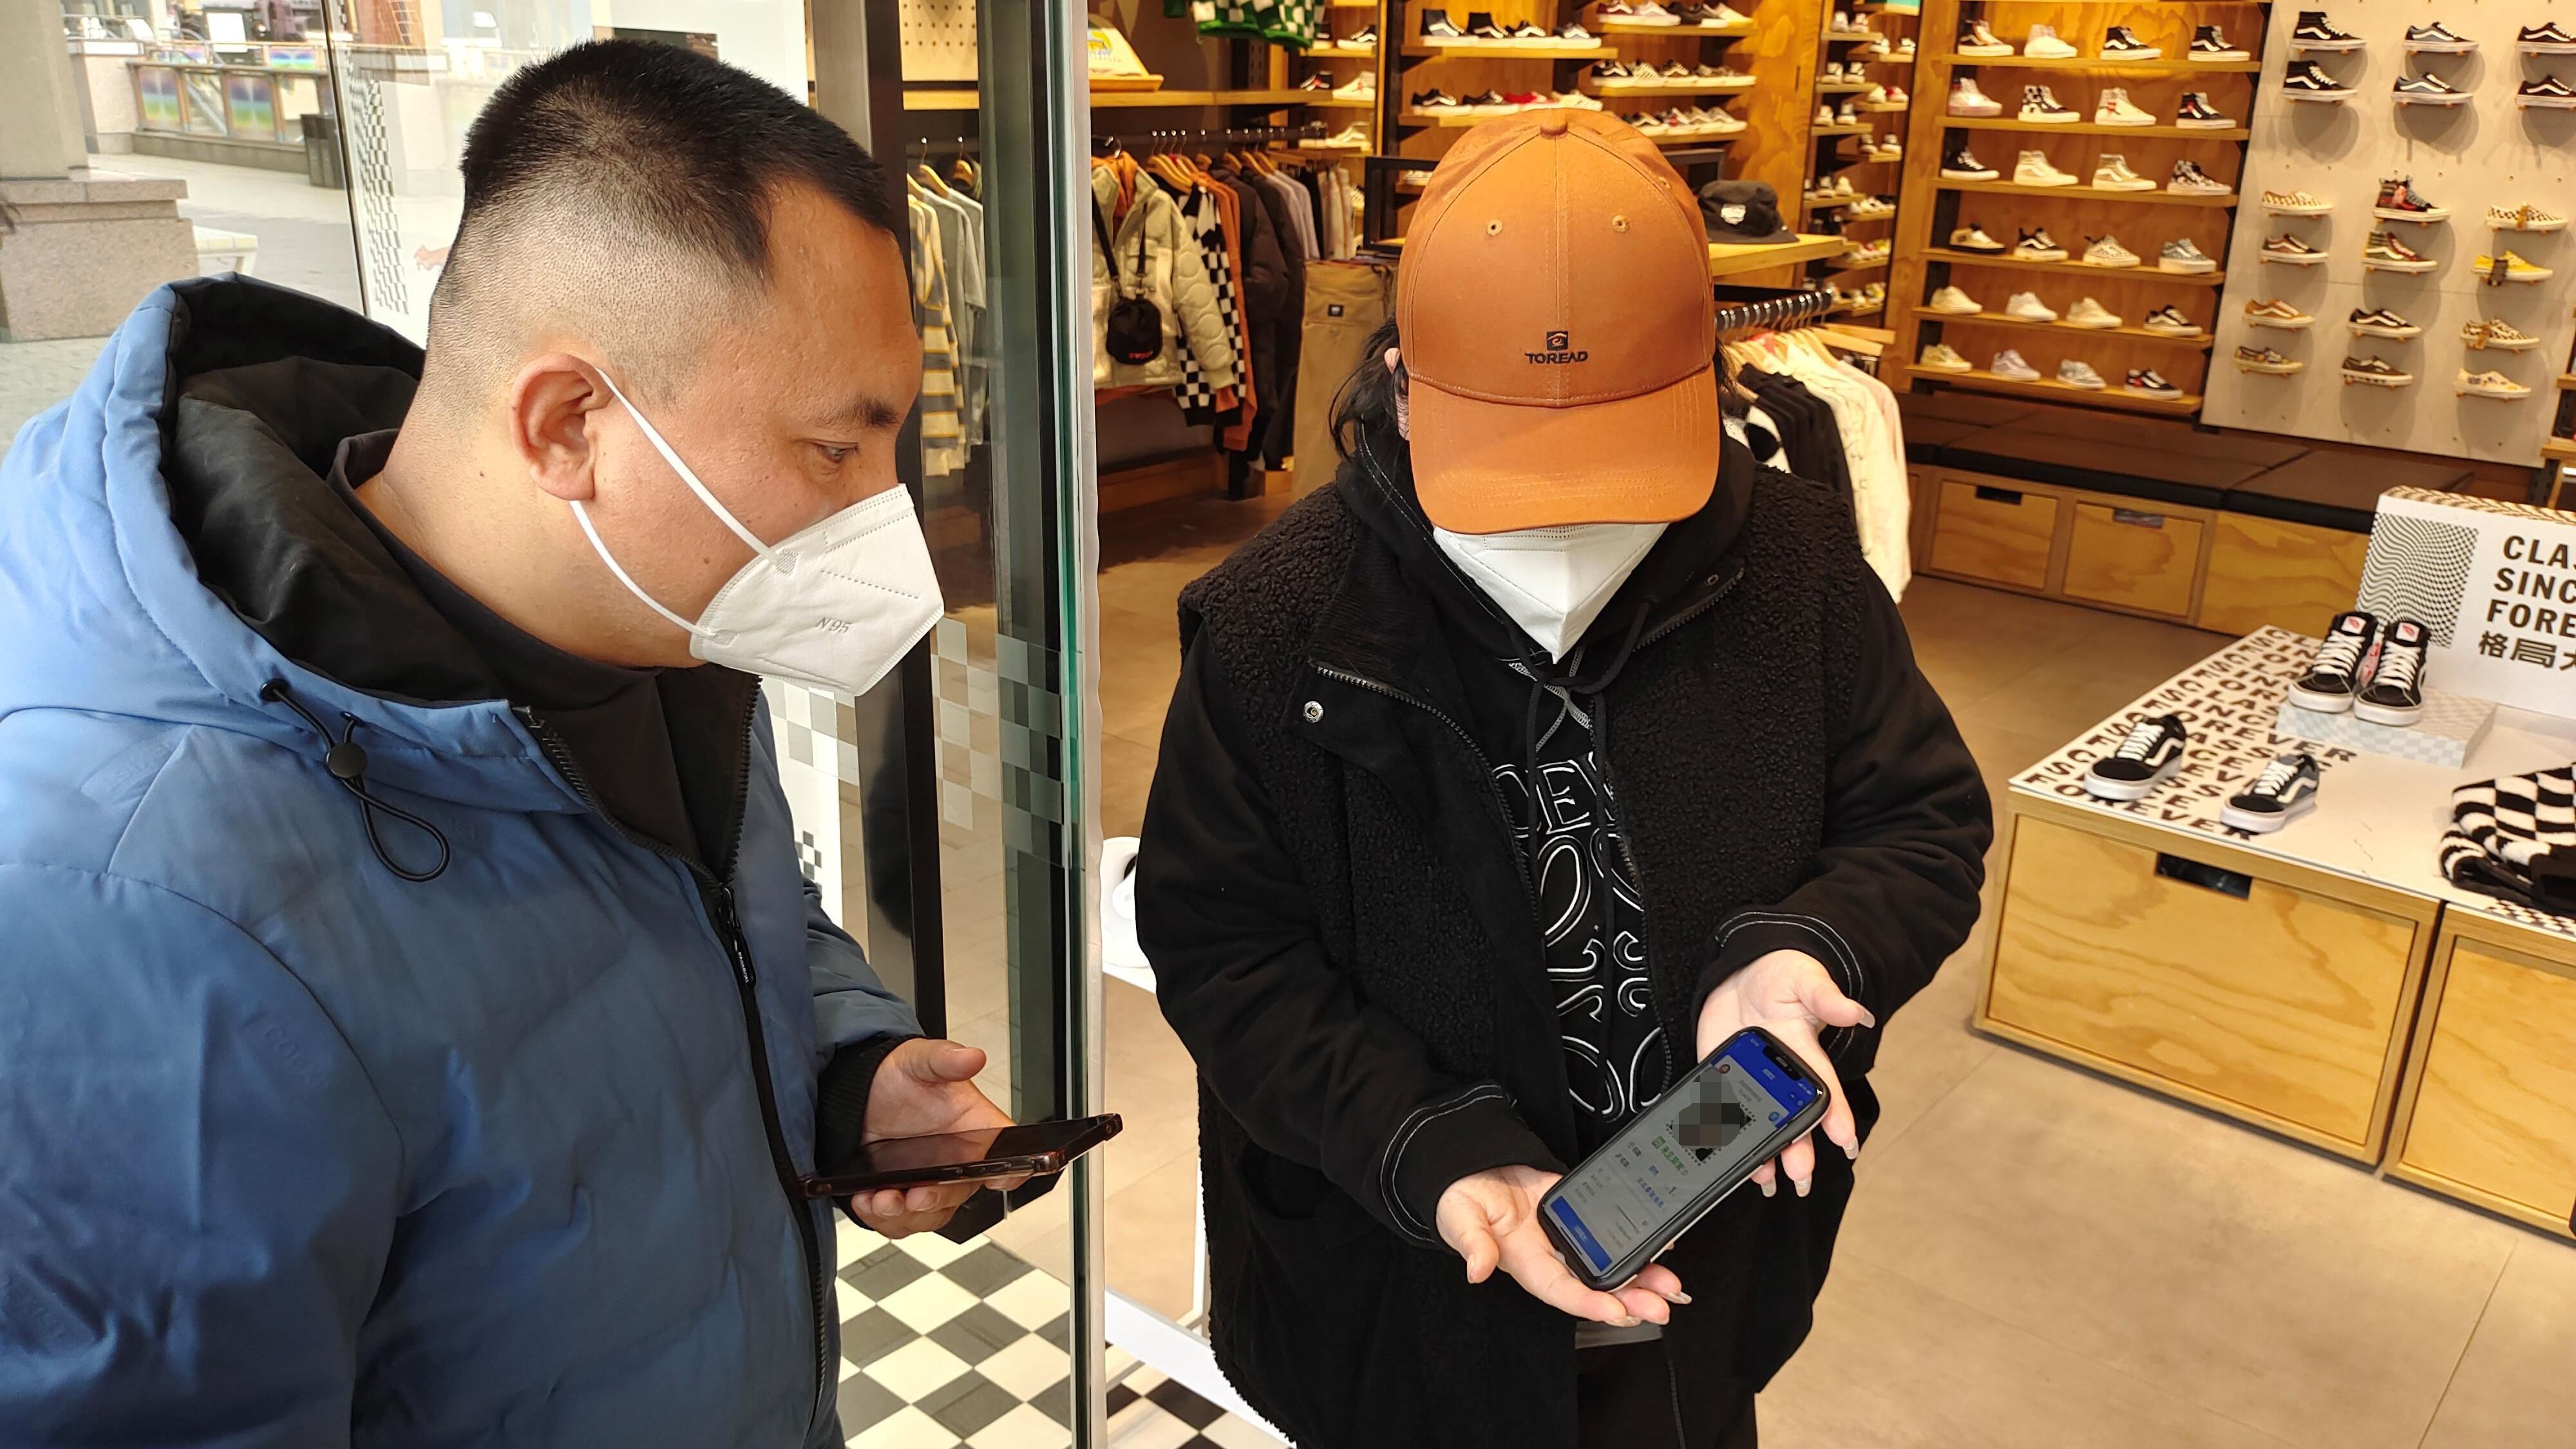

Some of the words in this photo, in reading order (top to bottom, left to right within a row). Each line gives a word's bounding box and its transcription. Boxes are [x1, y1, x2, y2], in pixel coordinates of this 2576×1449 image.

[1525, 351, 1588, 364] TOREAD
[2503, 535, 2576, 571] CLA
[2494, 567, 2576, 604] SINC
[815, 617, 852, 634] N95
[2486, 598, 2576, 638] FORE
[2207, 660, 2289, 690] SIN
[2158, 688, 2277, 729] SINC
[2141, 699, 2358, 762] FOREVER
